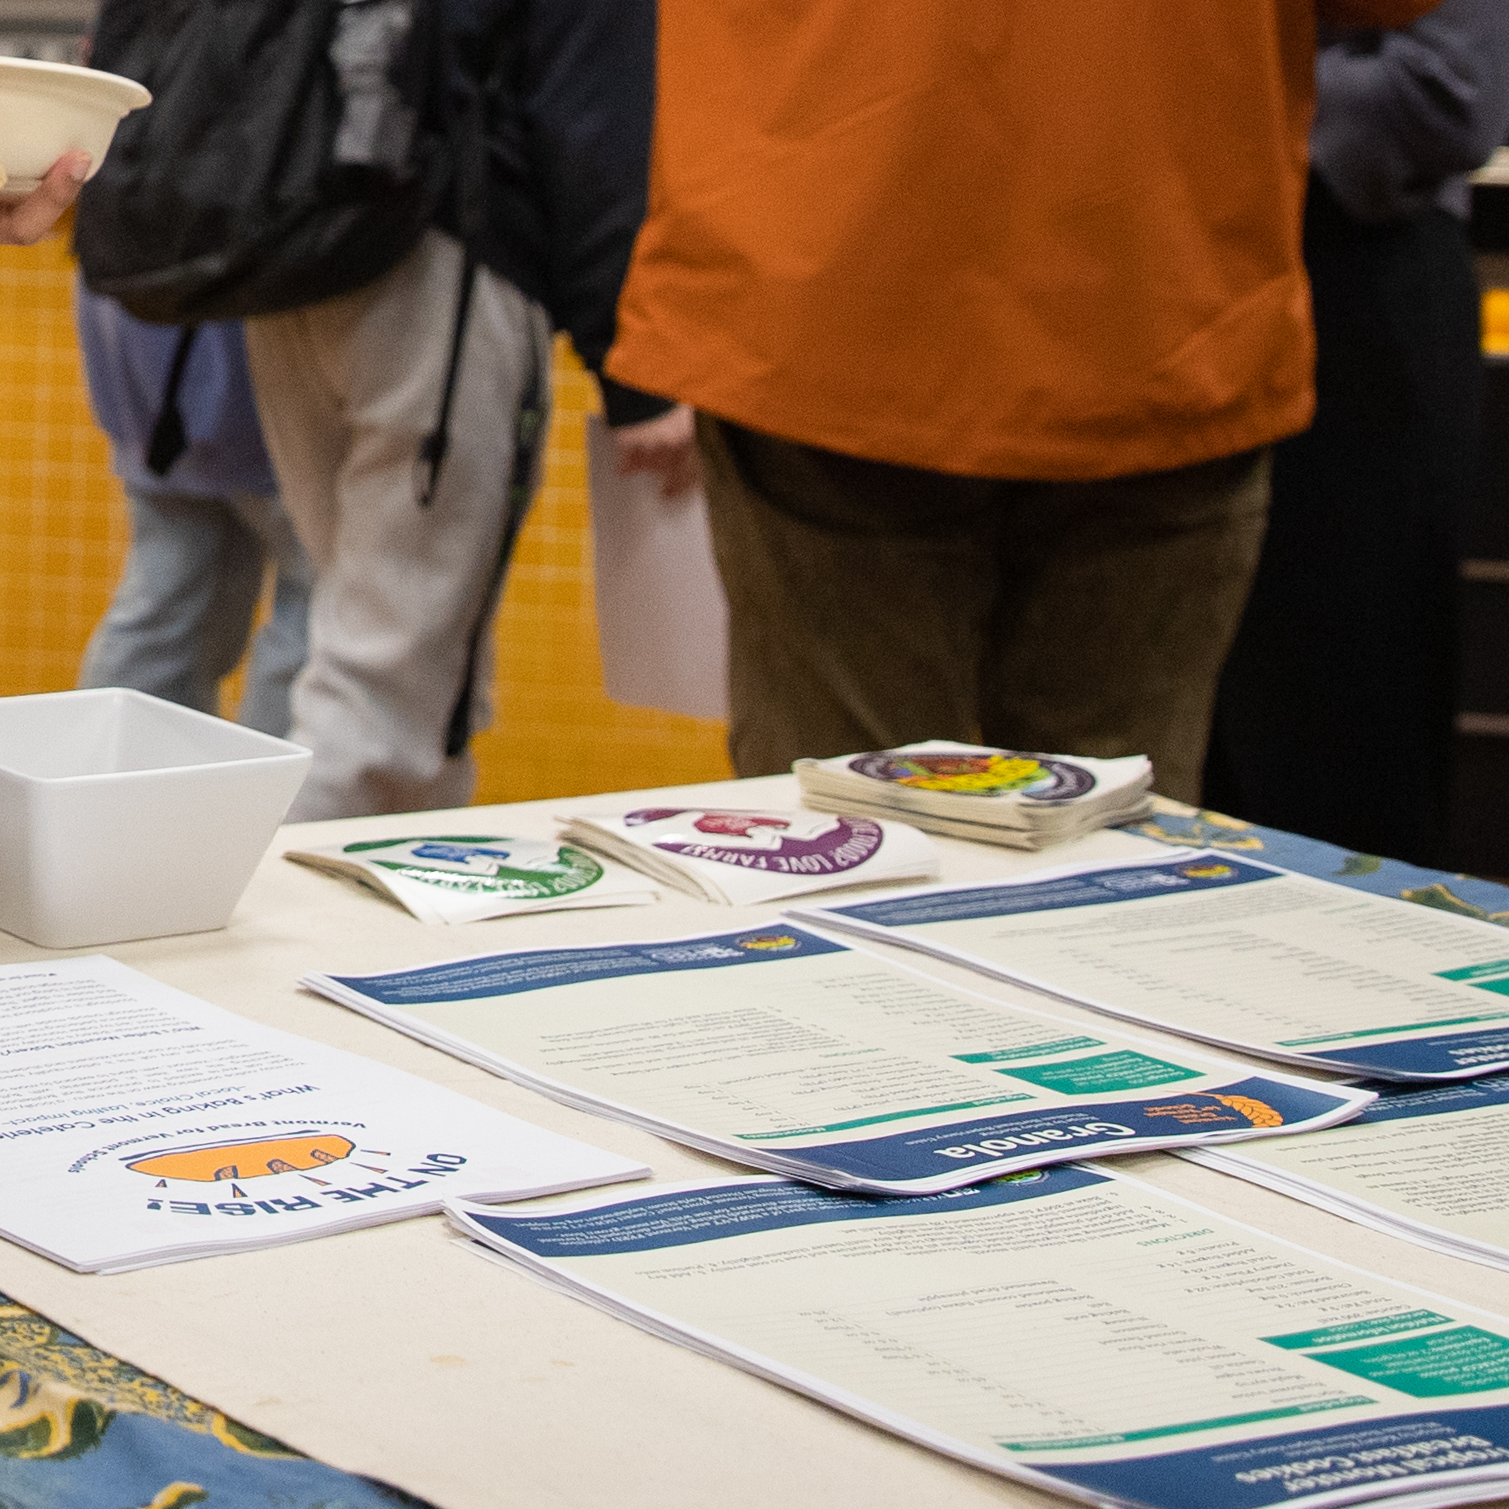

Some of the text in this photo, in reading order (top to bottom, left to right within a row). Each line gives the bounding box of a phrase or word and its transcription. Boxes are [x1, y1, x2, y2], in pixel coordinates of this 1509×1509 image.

[772, 853, 834, 874] LOVE
[130, 1095, 194, 1106] Choice,
[243, 1085, 312, 1100] What's
[70, 1105, 128, 1115] Lasting
[162, 1098, 243, 1114] Baking
[99, 1115, 139, 1123] the
[207, 1121, 267, 1131] Bread
[273, 1120, 365, 1128] Vermont
[103, 1133, 171, 1150] Vermont
[933, 1121, 1136, 1162] Granola
[148, 1154, 466, 1215] ON THE RISE!
[1137, 1229, 1213, 1246] DIRECTIONS
[1234, 1434, 1493, 1483] Breakfast Cookies
[1284, 1459, 1403, 1493] Monster
